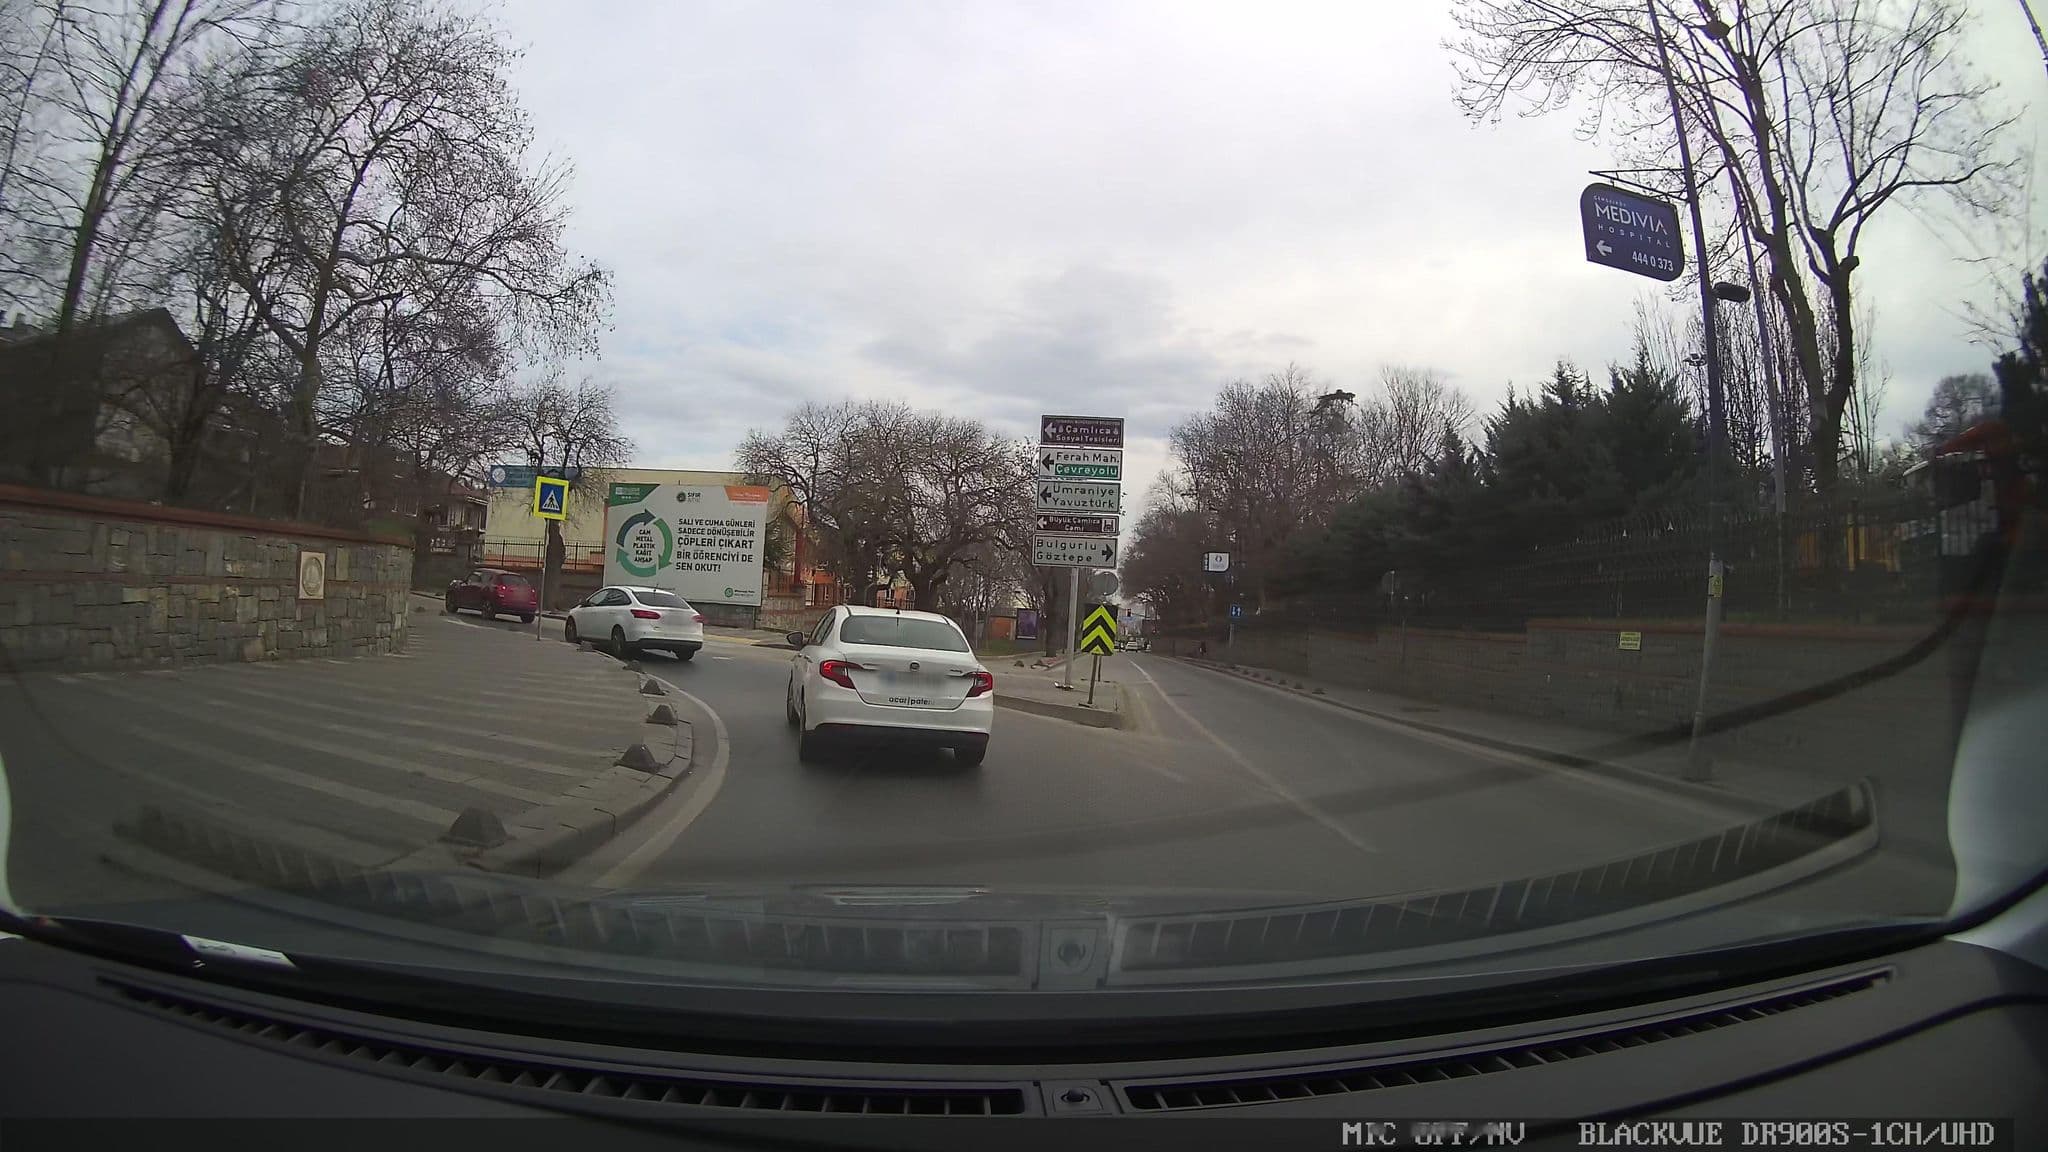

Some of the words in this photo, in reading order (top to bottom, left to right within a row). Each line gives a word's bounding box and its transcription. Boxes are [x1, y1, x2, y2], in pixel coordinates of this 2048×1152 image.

[1595, 202, 1668, 235] MEDIVIA
[1598, 224, 1671, 248] HOSPITAL
[1632, 251, 1648, 265] 444
[1658, 257, 1674, 272] 373
[1056, 434, 1083, 442] Sosyal
[1056, 452, 1089, 462] Ferah
[1092, 453, 1120, 463] Mah.
[1056, 464, 1118, 477] Çevreyolu
[1052, 497, 1114, 509] Yavuztürk
[725, 519, 755, 528] GÜNLERİ
[678, 527, 705, 535] SADECE
[677, 535, 716, 548] ÇÖPLERİ
[719, 538, 754, 550] ÇIKART
[1036, 539, 1097, 550] Bulgurlu
[676, 549, 691, 560] BİR
[693, 550, 739, 562] ÖĞRENCİYİ
[741, 554, 753, 563] DE
[1036, 552, 1092, 563] Göztepe
[675, 562, 693, 570] SEN
[695, 563, 721, 572] OKUT!
